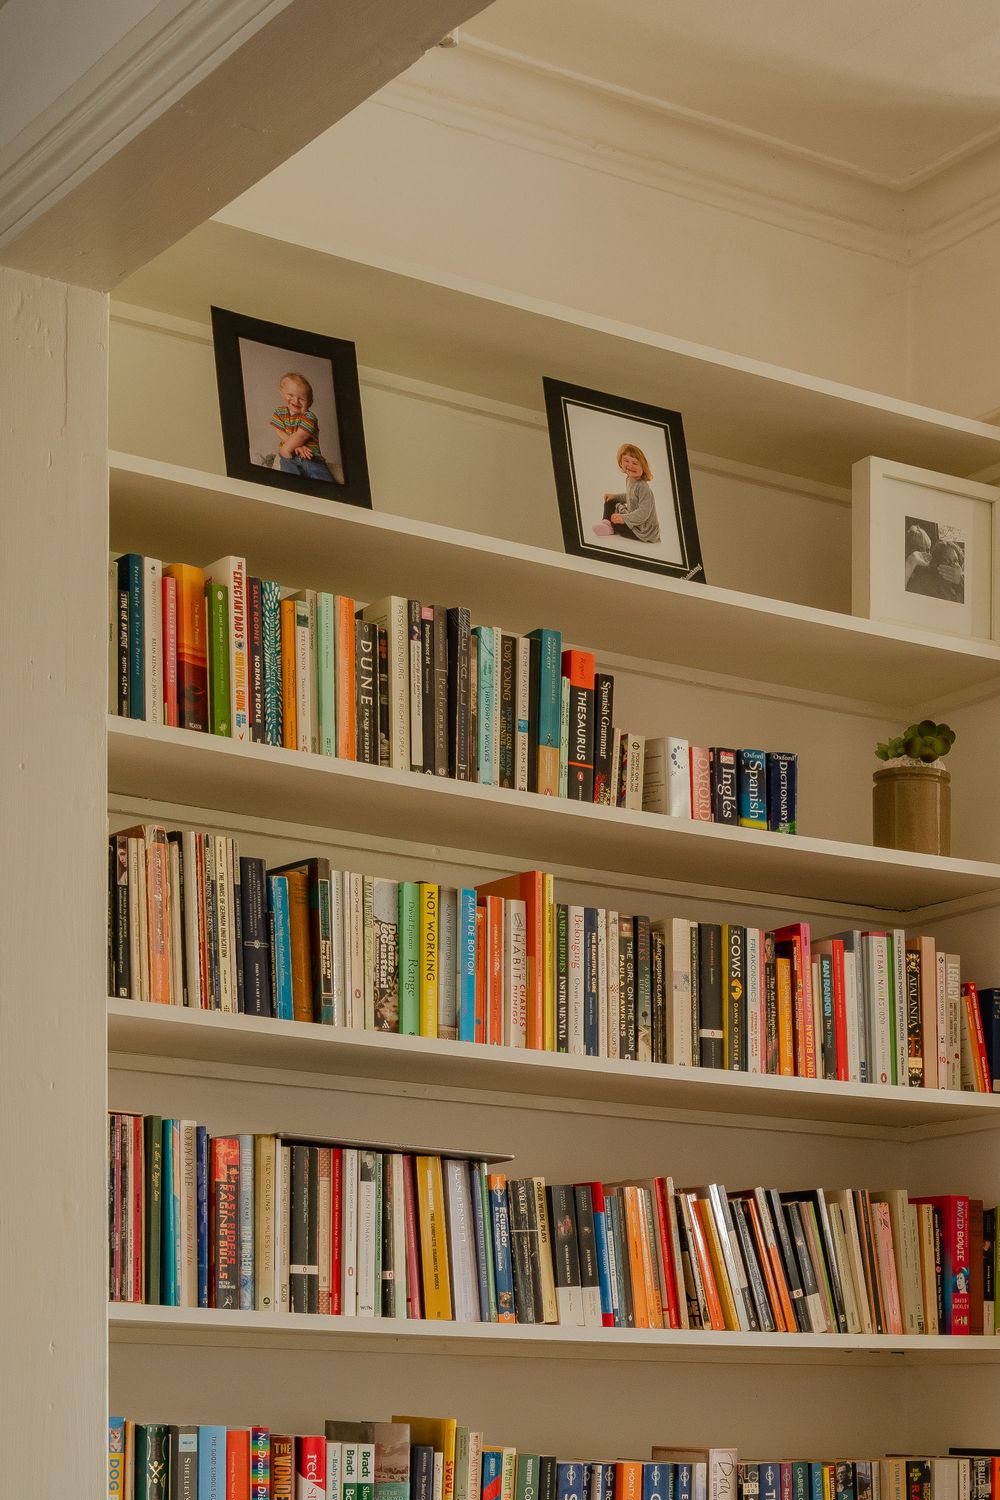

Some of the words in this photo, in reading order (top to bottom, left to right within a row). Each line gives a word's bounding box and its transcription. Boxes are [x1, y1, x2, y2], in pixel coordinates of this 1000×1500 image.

[232, 571, 243, 617] EXPECTANT
[235, 618, 244, 639] DAD'S
[269, 611, 277, 654] Swansong
[235, 651, 244, 690] SURVIVAL
[503, 640, 512, 664] TOBY
[269, 665, 277, 689] Kerry
[360, 640, 373, 706] DUNE
[503, 665, 512, 701] YOUNG
[236, 690, 245, 712] GUIDE
[600, 681, 611, 716] Spanish
[399, 725, 405, 735] TO
[484, 723, 490, 732] OF
[576, 691, 587, 761] THESAURUS
[599, 716, 610, 759] Grammar
[698, 758, 710, 820] OXFORD
[717, 767, 736, 818] Inglés
[744, 760, 764, 819] Spanish
[779, 761, 788, 823] DICTIONARY
[426, 891, 435, 918] NOT
[467, 895, 475, 923] ALAIN
[387, 923, 396, 973] Deleuze
[467, 925, 475, 936] DE
[571, 914, 584, 969] Belonging
[426, 921, 435, 981] WORKING
[467, 939, 475, 976] BOTTON
[512, 933, 521, 981] HABIT
[731, 935, 741, 978] COWS
[822, 960, 830, 978] IAN
[405, 958, 418, 997] Range
[627, 986, 633, 1000] ON
[947, 963, 960, 1001] LEGACY
[823, 979, 831, 1017] RANKIN
[807, 1057, 815, 1078] TONY
[219, 1184, 228, 1236] RAGING
[499, 1207, 508, 1248] Ecuador
[219, 1240, 228, 1279] BULLS
[257, 1432, 266, 1484] No-Drama
[274, 1443, 291, 1454] THE
[346, 1449, 354, 1476] Bradt
[362, 1451, 370, 1478] Bradt
[505, 1453, 512, 1467] We
[109, 1459, 120, 1491] DOG
[306, 1454, 322, 1483] red
[504, 1469, 512, 1490] Want
[717, 1454, 735, 1497] Don
